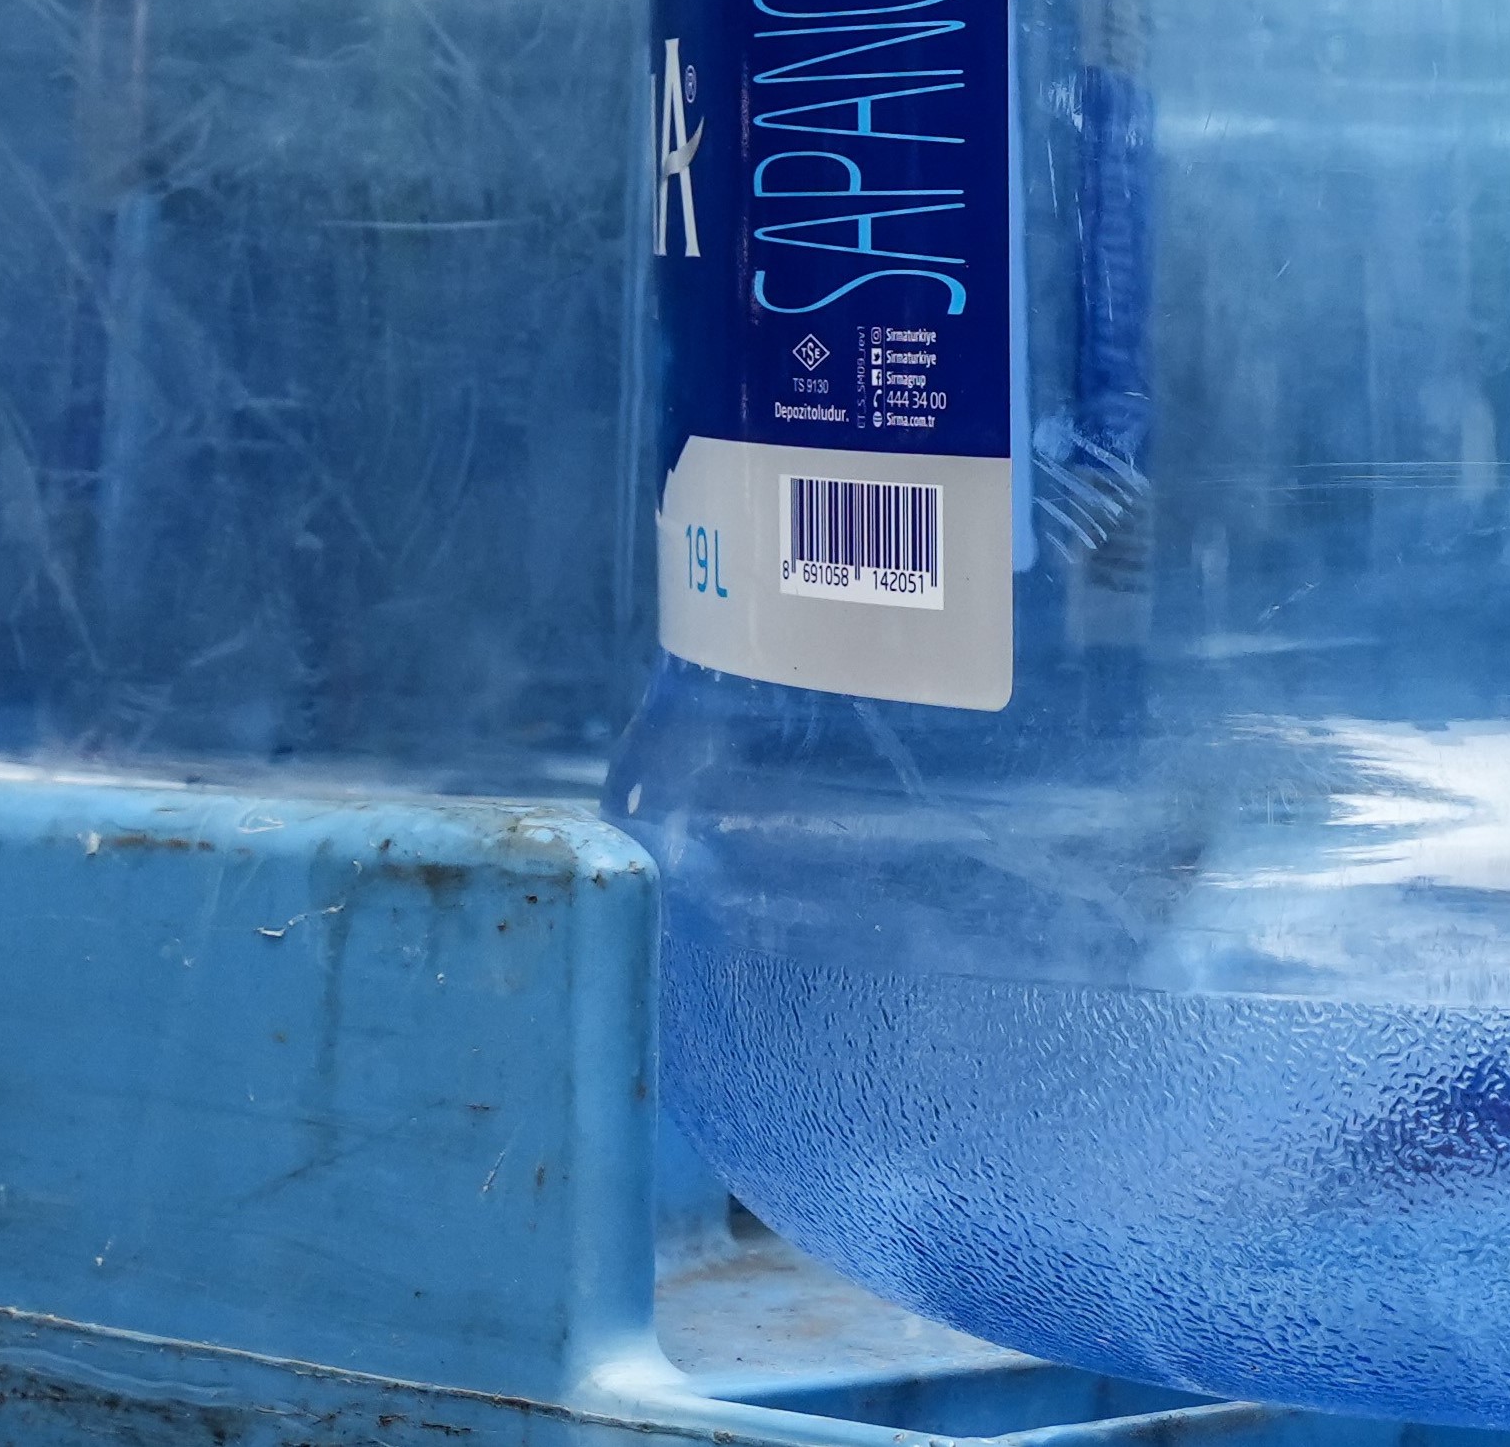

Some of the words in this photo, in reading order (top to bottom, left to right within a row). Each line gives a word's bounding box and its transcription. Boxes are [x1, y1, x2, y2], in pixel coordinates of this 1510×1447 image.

[793, 377, 805, 393] TS
[807, 377, 829, 394] 9130
[885, 371, 927, 388] Sirmagrup
[886, 390, 910, 408] 444
[912, 390, 928, 409] 34
[930, 391, 947, 410] 00
[774, 401, 850, 423] Depozitoludur.
[885, 412, 936, 429] Sirma.com.tr
[685, 524, 708, 593] 19
[714, 529, 729, 598] L
[783, 560, 790, 581] 8
[803, 562, 850, 588] 691058
[872, 569, 925, 595] 142051
